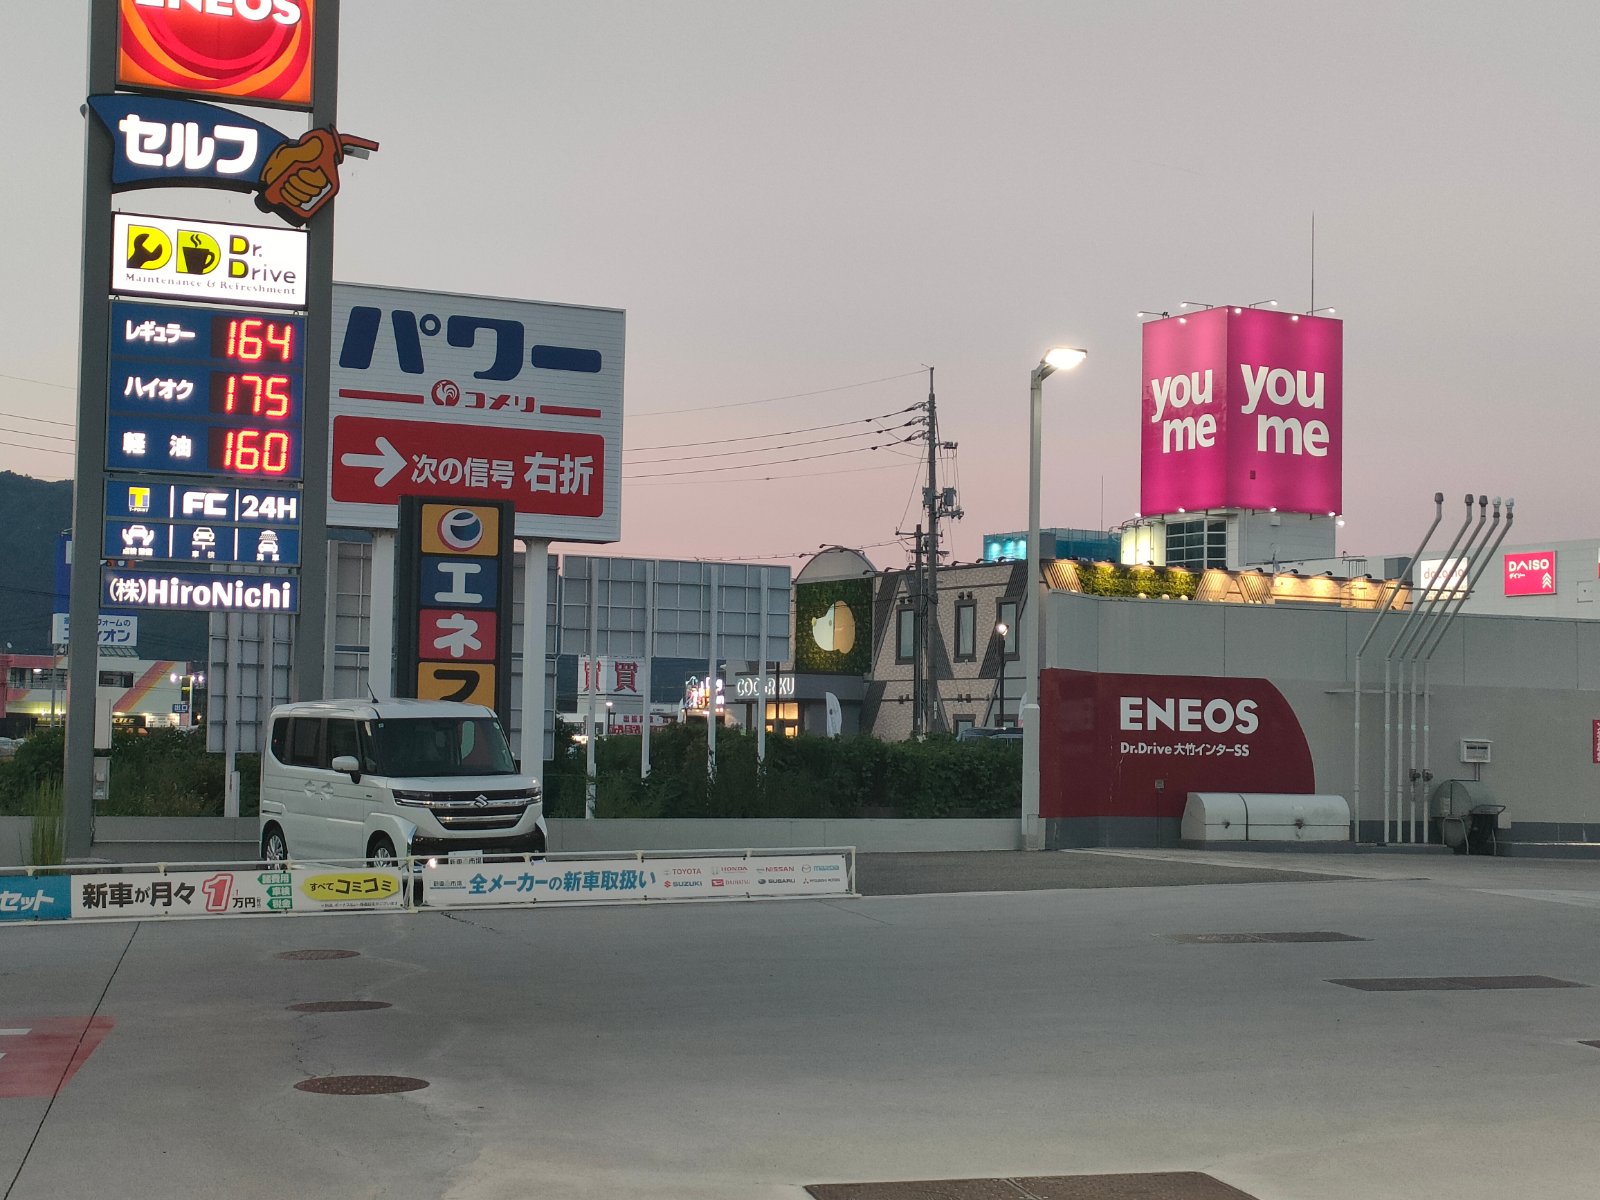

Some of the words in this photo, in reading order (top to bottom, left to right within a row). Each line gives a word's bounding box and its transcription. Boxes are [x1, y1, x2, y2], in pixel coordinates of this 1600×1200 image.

[118, 113, 258, 174] セルフ
[229, 234, 262, 257] Dr.
[125, 273, 202, 287] Maintenance
[207, 280, 216, 288] &
[220, 281, 296, 295] Refreshment
[228, 258, 296, 284] Drive
[125, 319, 196, 343] レギュラー
[226, 319, 293, 361] 164
[339, 305, 602, 382] パワー
[124, 376, 194, 400] ハイオク
[225, 375, 289, 418] 175
[465, 391, 535, 413] コメリ
[1151, 369, 1213, 423] you
[1240, 363, 1325, 415] you
[1163, 413, 1217, 453] me
[1257, 414, 1330, 457] me
[223, 430, 290, 472] 160
[411, 454, 515, 490] 次の信号
[524, 452, 593, 496] 右折
[183, 491, 229, 516] FC
[242, 495, 297, 519] 24H
[1508, 558, 1550, 572] DAISO
[614, 661, 640, 693] 買
[1120, 696, 1259, 734] ENEOS
[1120, 742, 1172, 755] Dr.Drive
[1174, 742, 1250, 757] 大竹インターSS
[468, 870, 656, 894] 全メーカーの新車取扱い
[0, 890, 54, 911] セット
